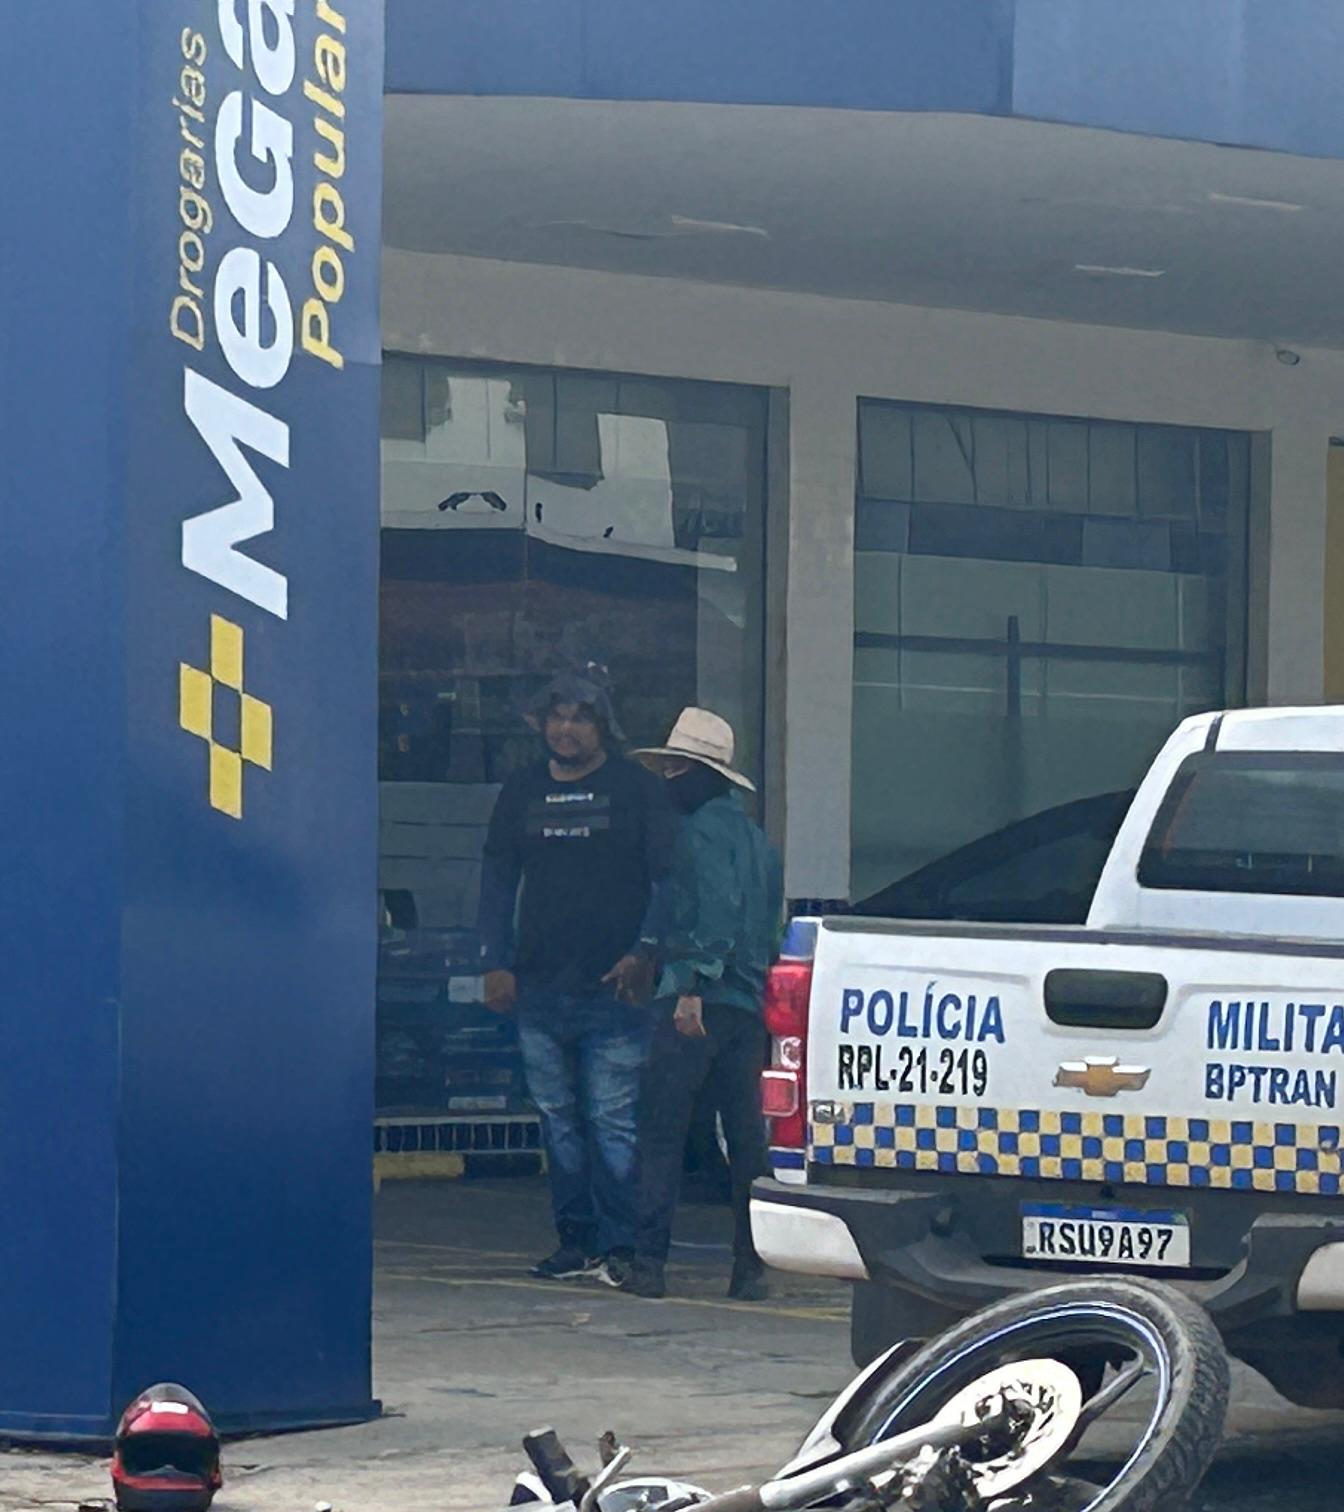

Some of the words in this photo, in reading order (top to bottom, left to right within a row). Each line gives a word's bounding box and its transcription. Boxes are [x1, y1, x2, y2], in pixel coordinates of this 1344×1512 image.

[170, 27, 213, 351] Drogarias
[302, 0, 354, 371] Popular
[840, 981, 1005, 1044] POLÍCIA
[1205, 1063, 1337, 1108] BPTRAN
[1038, 1222, 1174, 1260] RSU9A97
